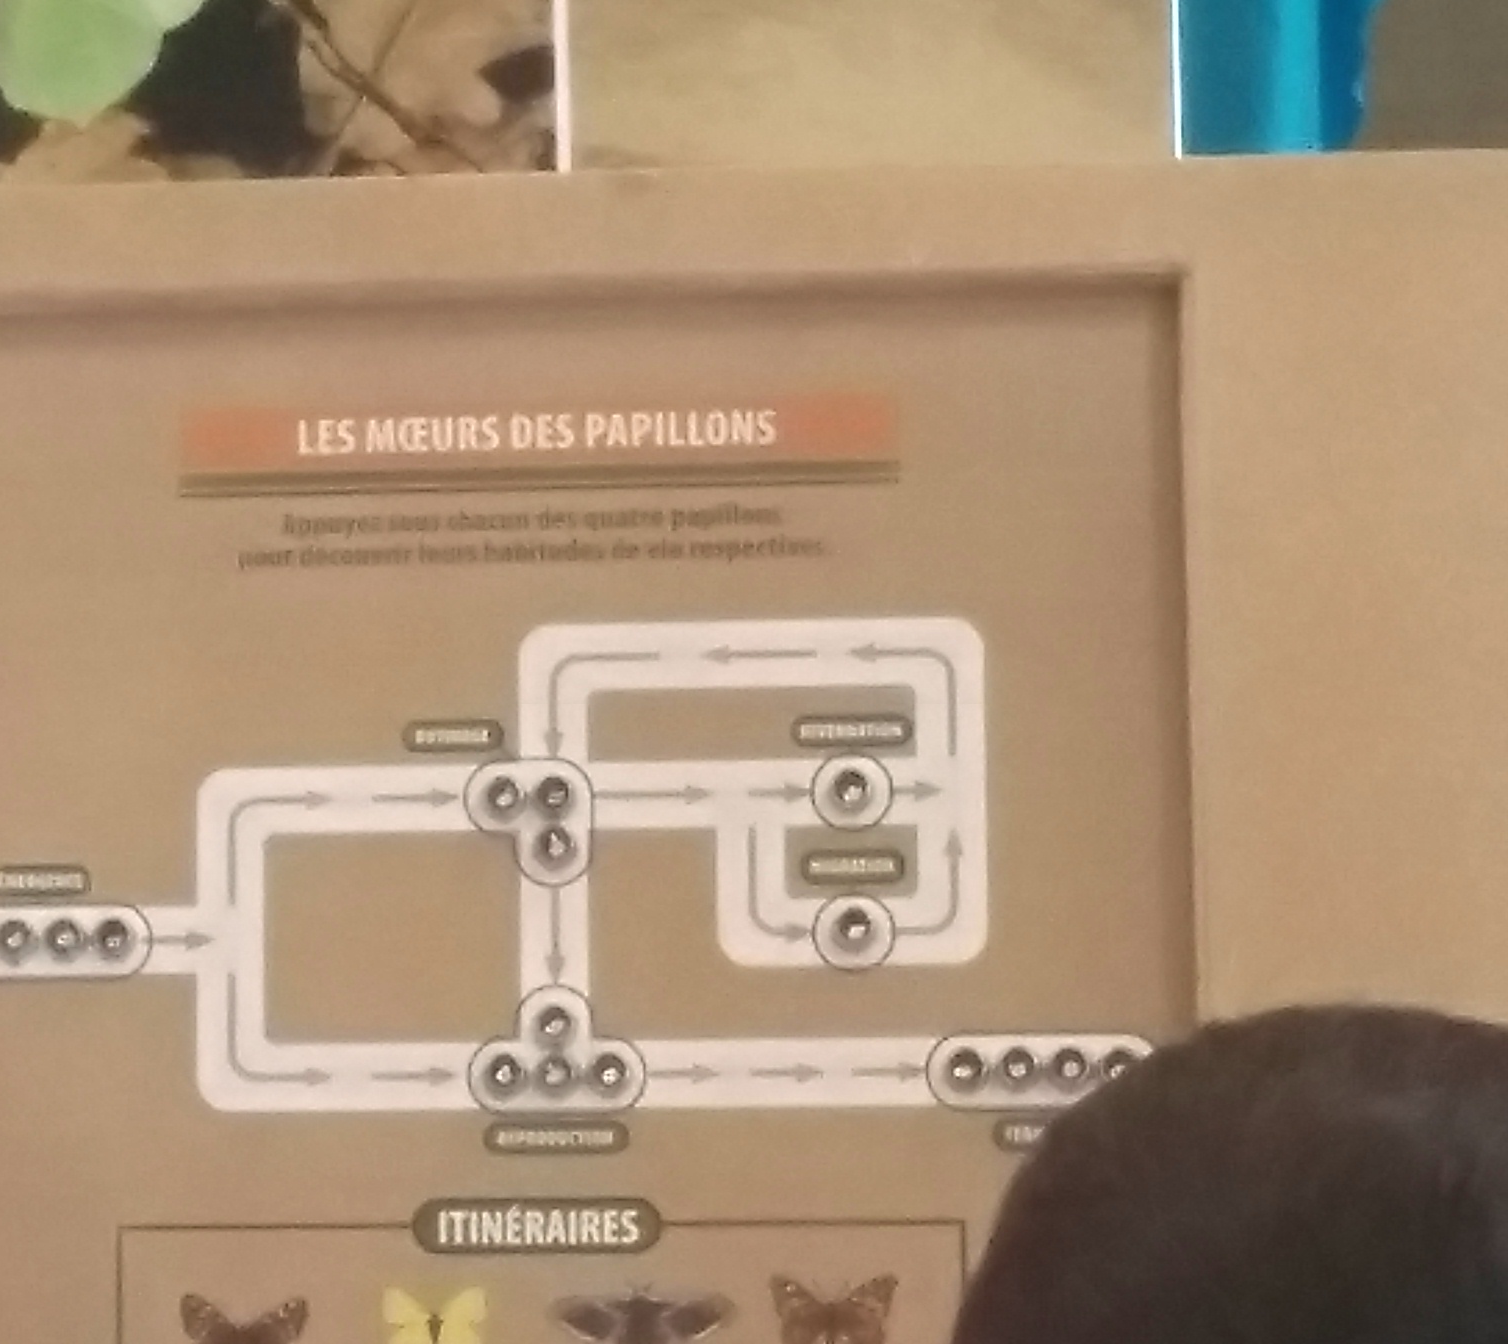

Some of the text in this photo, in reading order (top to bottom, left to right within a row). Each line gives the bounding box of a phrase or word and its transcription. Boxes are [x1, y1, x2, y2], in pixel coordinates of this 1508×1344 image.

[297, 408, 778, 455] LES MŒURS DES PAPILLONS
[436, 1204, 640, 1247] ITINÉRAIRES
